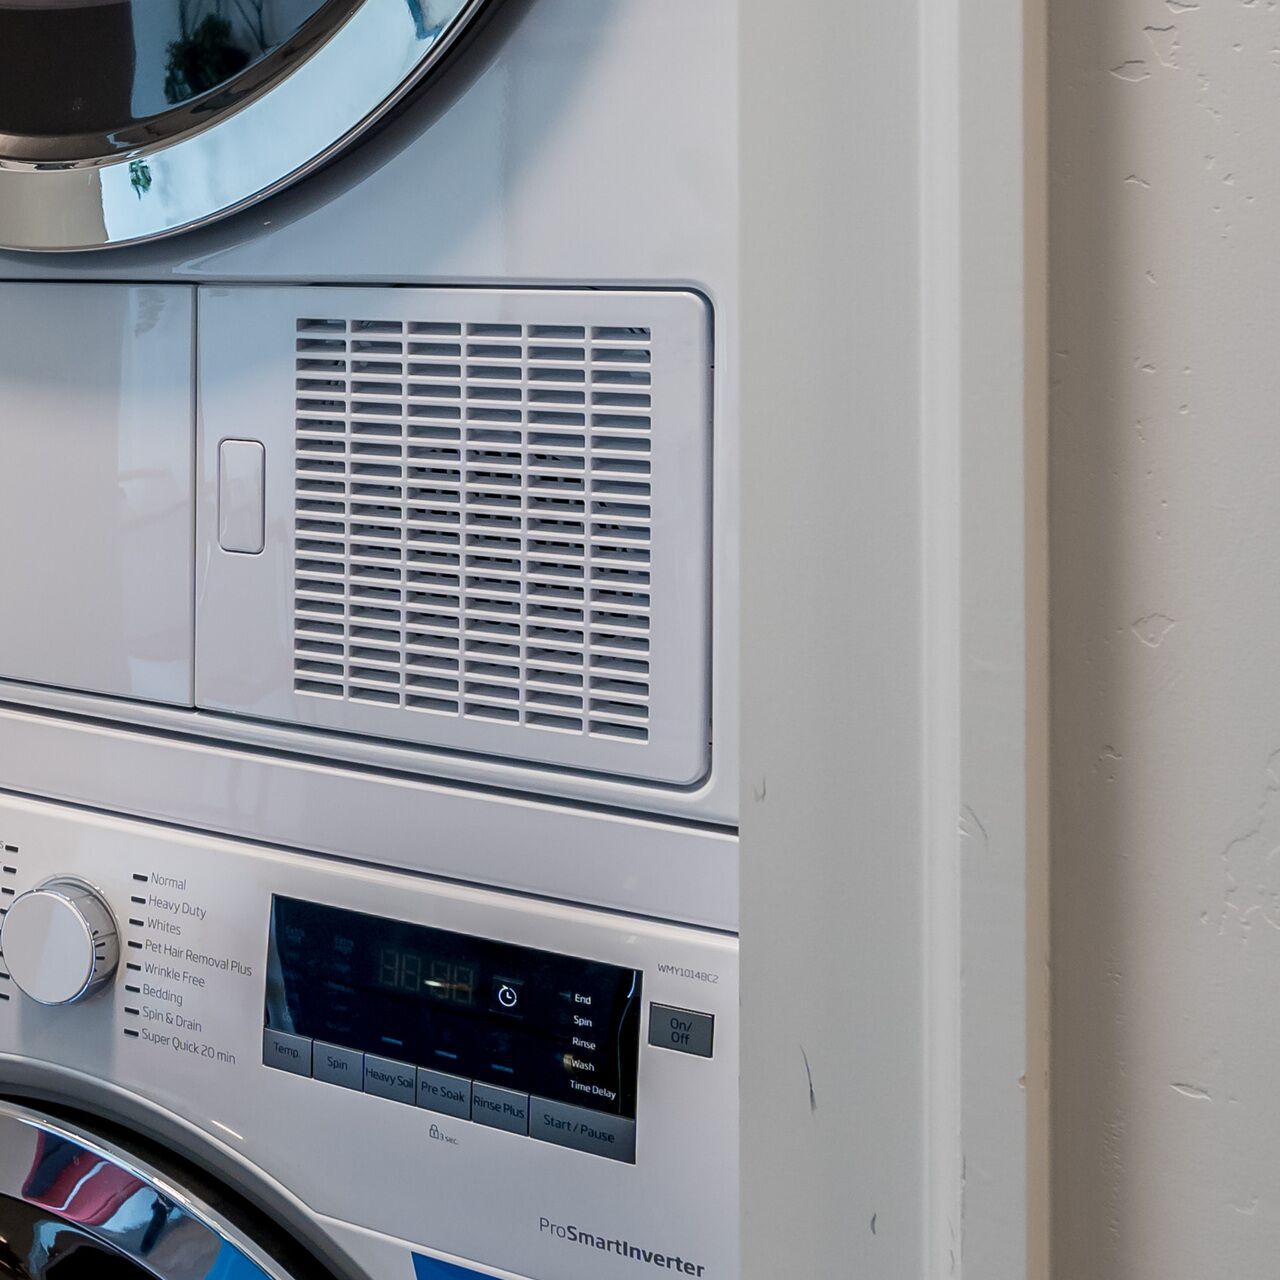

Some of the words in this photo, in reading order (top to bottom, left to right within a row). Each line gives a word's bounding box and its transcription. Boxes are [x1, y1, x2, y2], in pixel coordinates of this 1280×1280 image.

[151, 872, 186, 890] Normal
[148, 894, 180, 914] Heavy
[182, 902, 207, 920] Duty
[147, 917, 181, 935] Whites
[145, 939, 162, 954] Pet
[164, 944, 183, 958] Hair
[185, 949, 229, 971] Removal
[231, 960, 252, 977] Plus
[145, 962, 180, 981] Wrinkle
[182, 971, 205, 987] Free
[143, 984, 183, 1007] Bedding
[574, 993, 592, 1005] End
[143, 1006, 164, 1022] Spin
[165, 1012, 174, 1024] &
[176, 1015, 202, 1032] Drain
[573, 1015, 593, 1027] Spin
[670, 1018, 693, 1032] On/
[142, 1028, 170, 1045] Super
[172, 1037, 199, 1054] Quick
[201, 1045, 215, 1058] 20
[217, 1051, 236, 1064] min
[572, 1037, 597, 1050] Rinse
[671, 1032, 690, 1045] Off
[327, 1056, 348, 1071] Spin
[571, 1058, 595, 1072] Wash
[366, 1067, 396, 1086] Heavy
[397, 1075, 414, 1089] Soil
[421, 1080, 438, 1096] Pre
[441, 1086, 465, 1103] Soak
[570, 1080, 591, 1093] Time
[592, 1085, 617, 1100] Delay
[473, 1095, 502, 1112] Rinse
[503, 1103, 525, 1119] Plus
[543, 1113, 572, 1132] Start
[580, 1124, 615, 1144] Pause
[539, 1217, 705, 1278] ProSmartInverter
